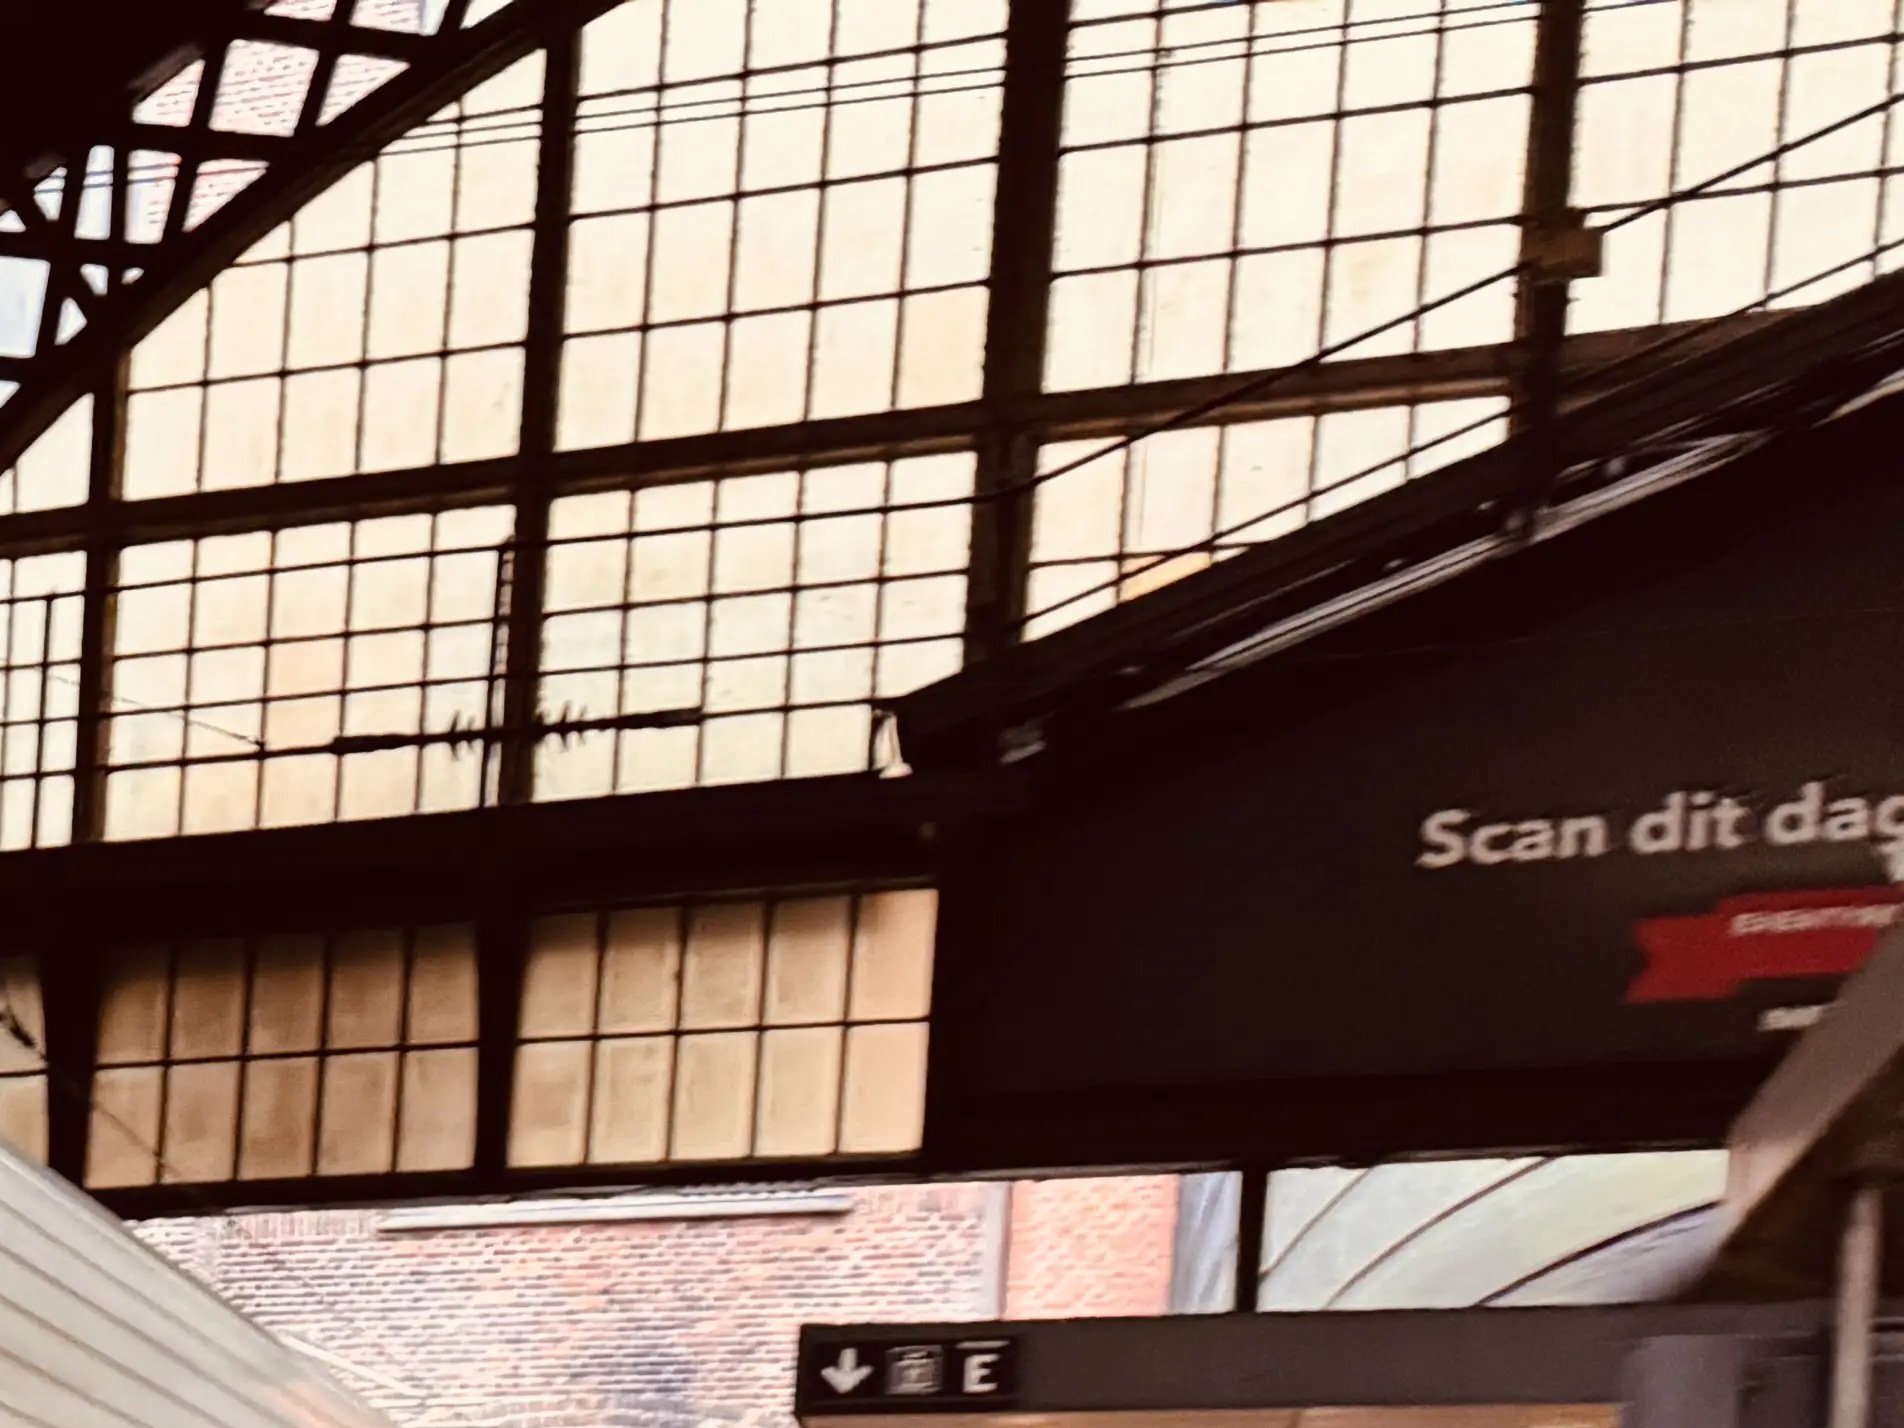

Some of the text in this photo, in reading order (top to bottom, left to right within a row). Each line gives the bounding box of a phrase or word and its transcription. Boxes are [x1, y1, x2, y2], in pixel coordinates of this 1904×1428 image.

[1416, 808, 1609, 868] Scan
[1629, 790, 1749, 855] dit
[961, 1353, 1000, 1394] E
